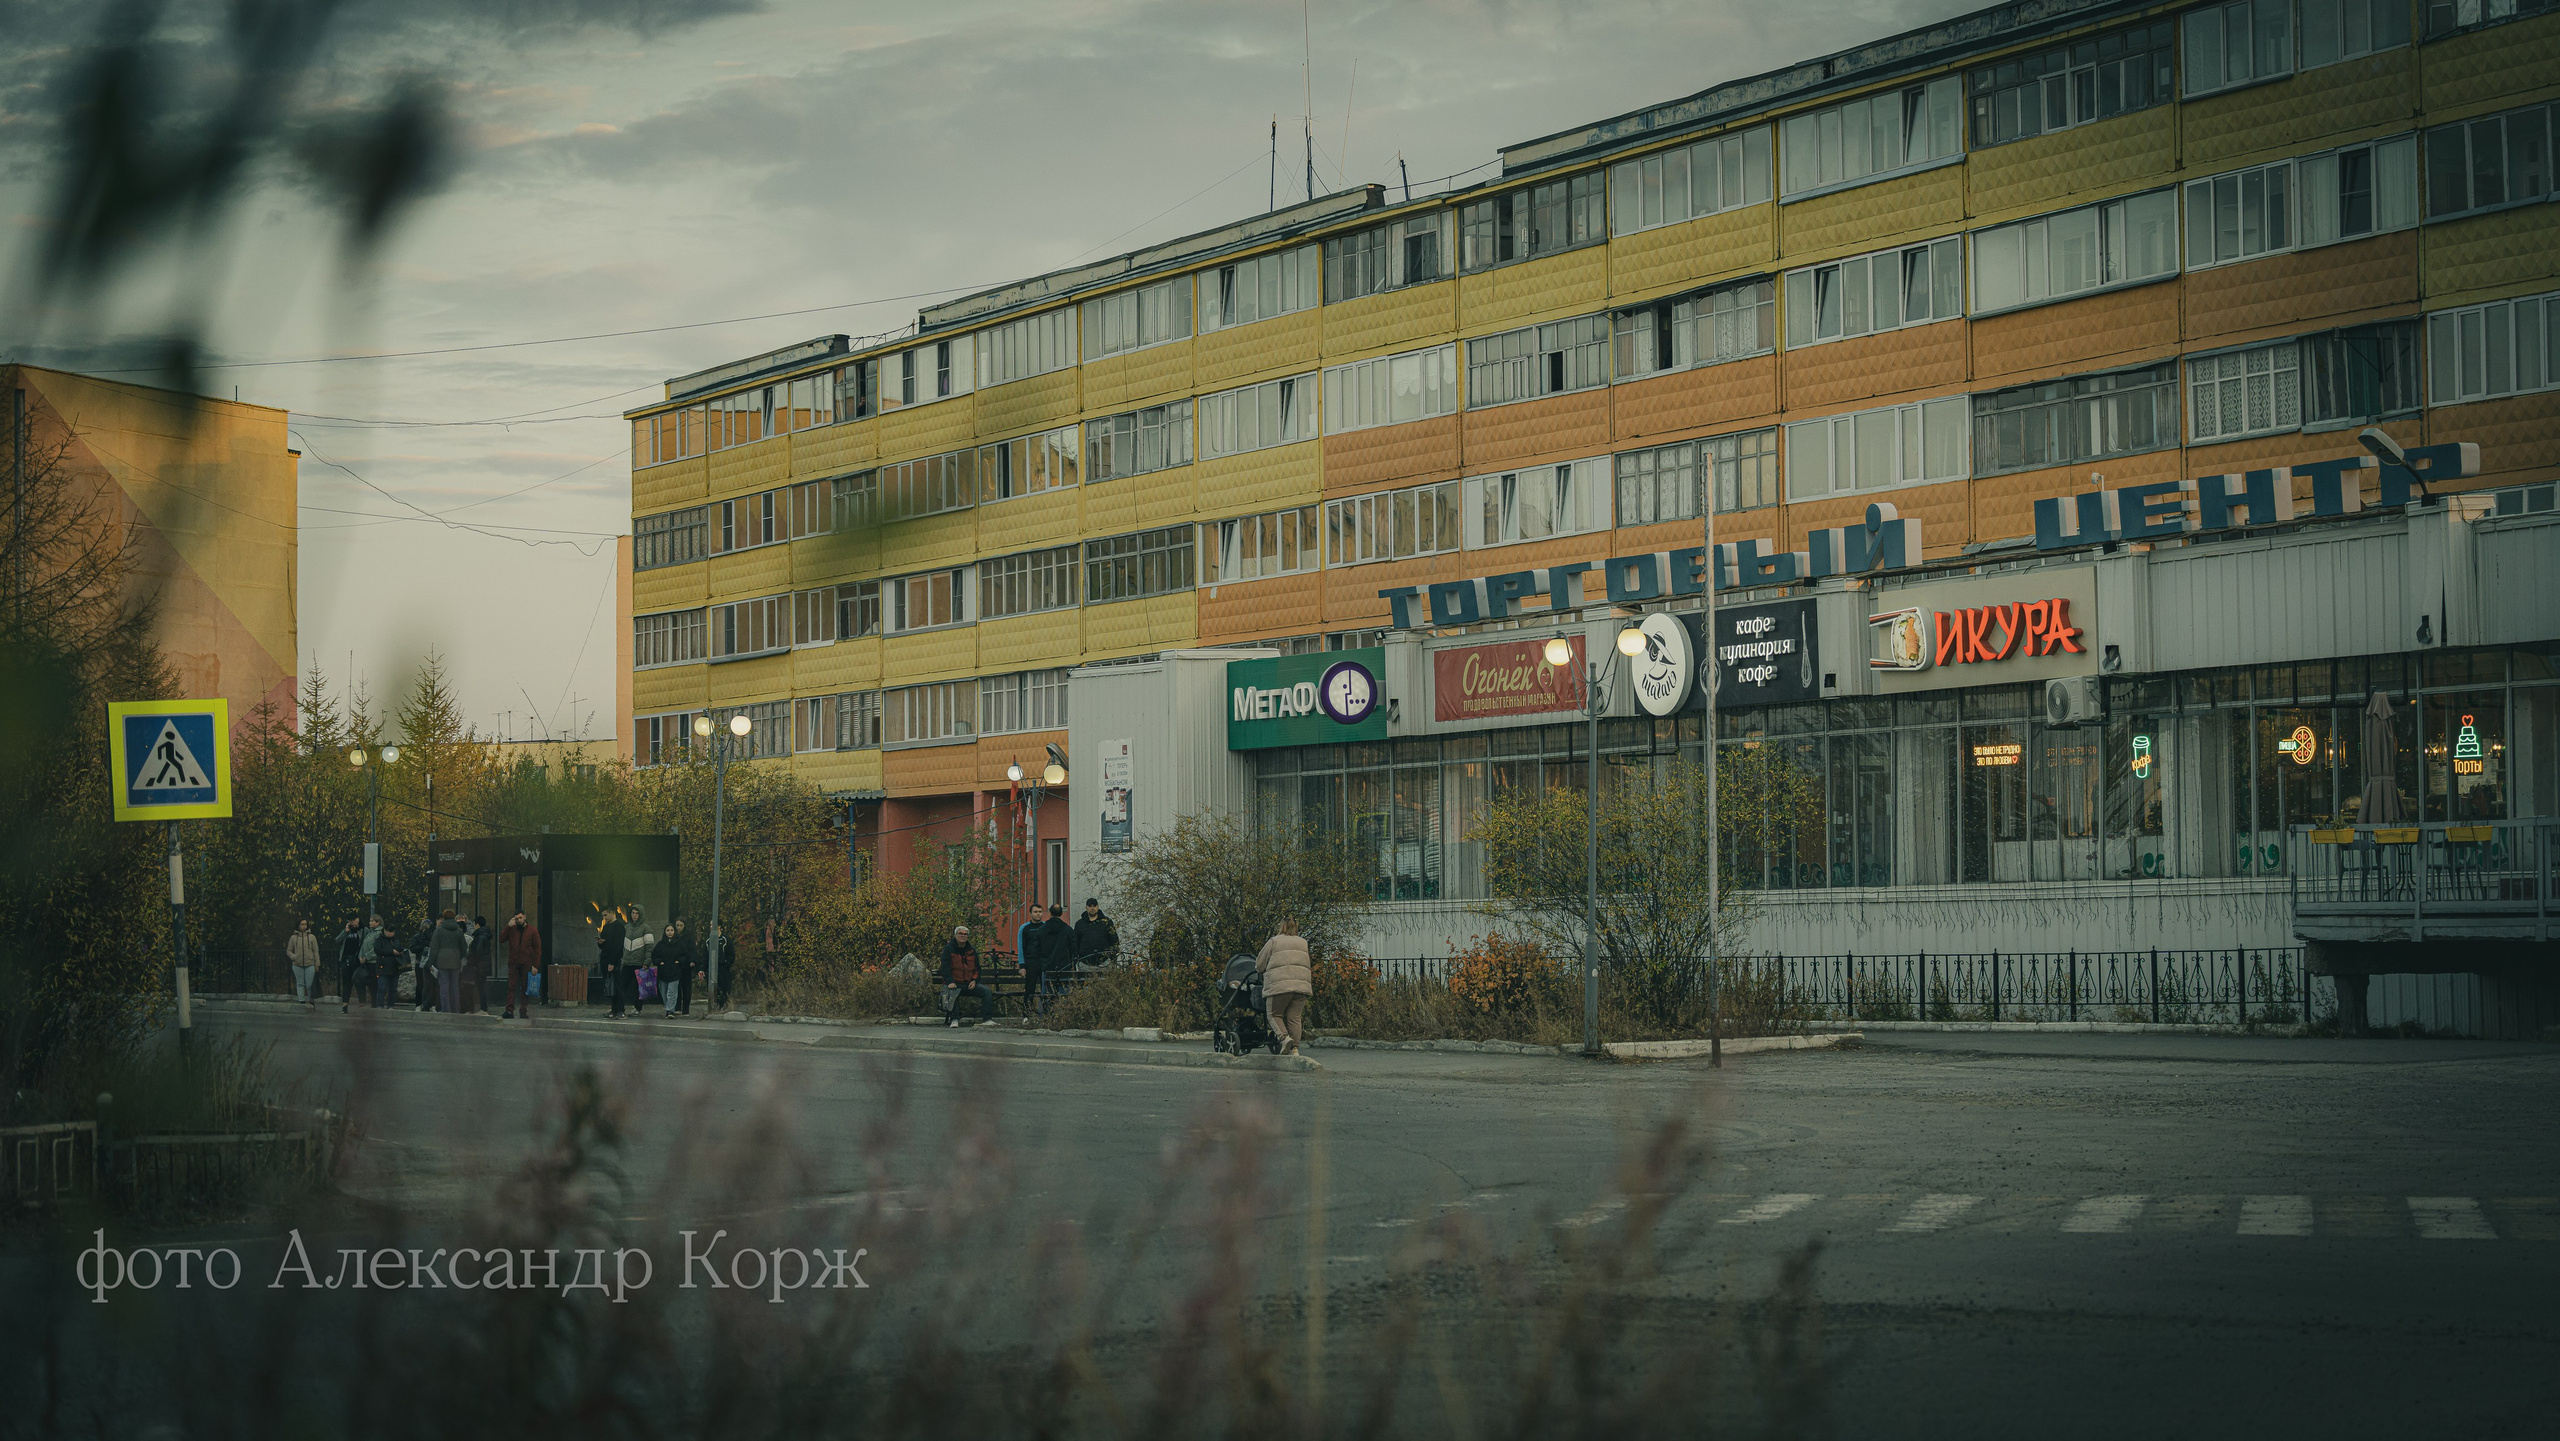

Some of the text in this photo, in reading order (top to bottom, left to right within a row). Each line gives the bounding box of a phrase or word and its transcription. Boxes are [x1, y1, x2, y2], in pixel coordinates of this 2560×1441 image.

[1379, 442, 2480, 628] ТОРГОВЫЙ ЦЕНТР
[1736, 617, 1775, 638] кафе
[1934, 598, 2086, 667] ИКУРА
[1720, 639, 1795, 667] кулинария
[1463, 653, 1533, 696] Огонёк
[1738, 664, 1777, 686] кофе
[1463, 692, 1556, 712] ПРОДОВОЛЬСТВЕННЫЙ МАГАЗИН
[1974, 747, 1982, 755] ЭТО
[1983, 746, 1995, 755] БЫЛО
[2278, 741, 2297, 751] ПИЦЦА
[1977, 756, 2012, 766] ЭТО ПО ЛЮБВИ
[2453, 759, 2482, 775] Торты
